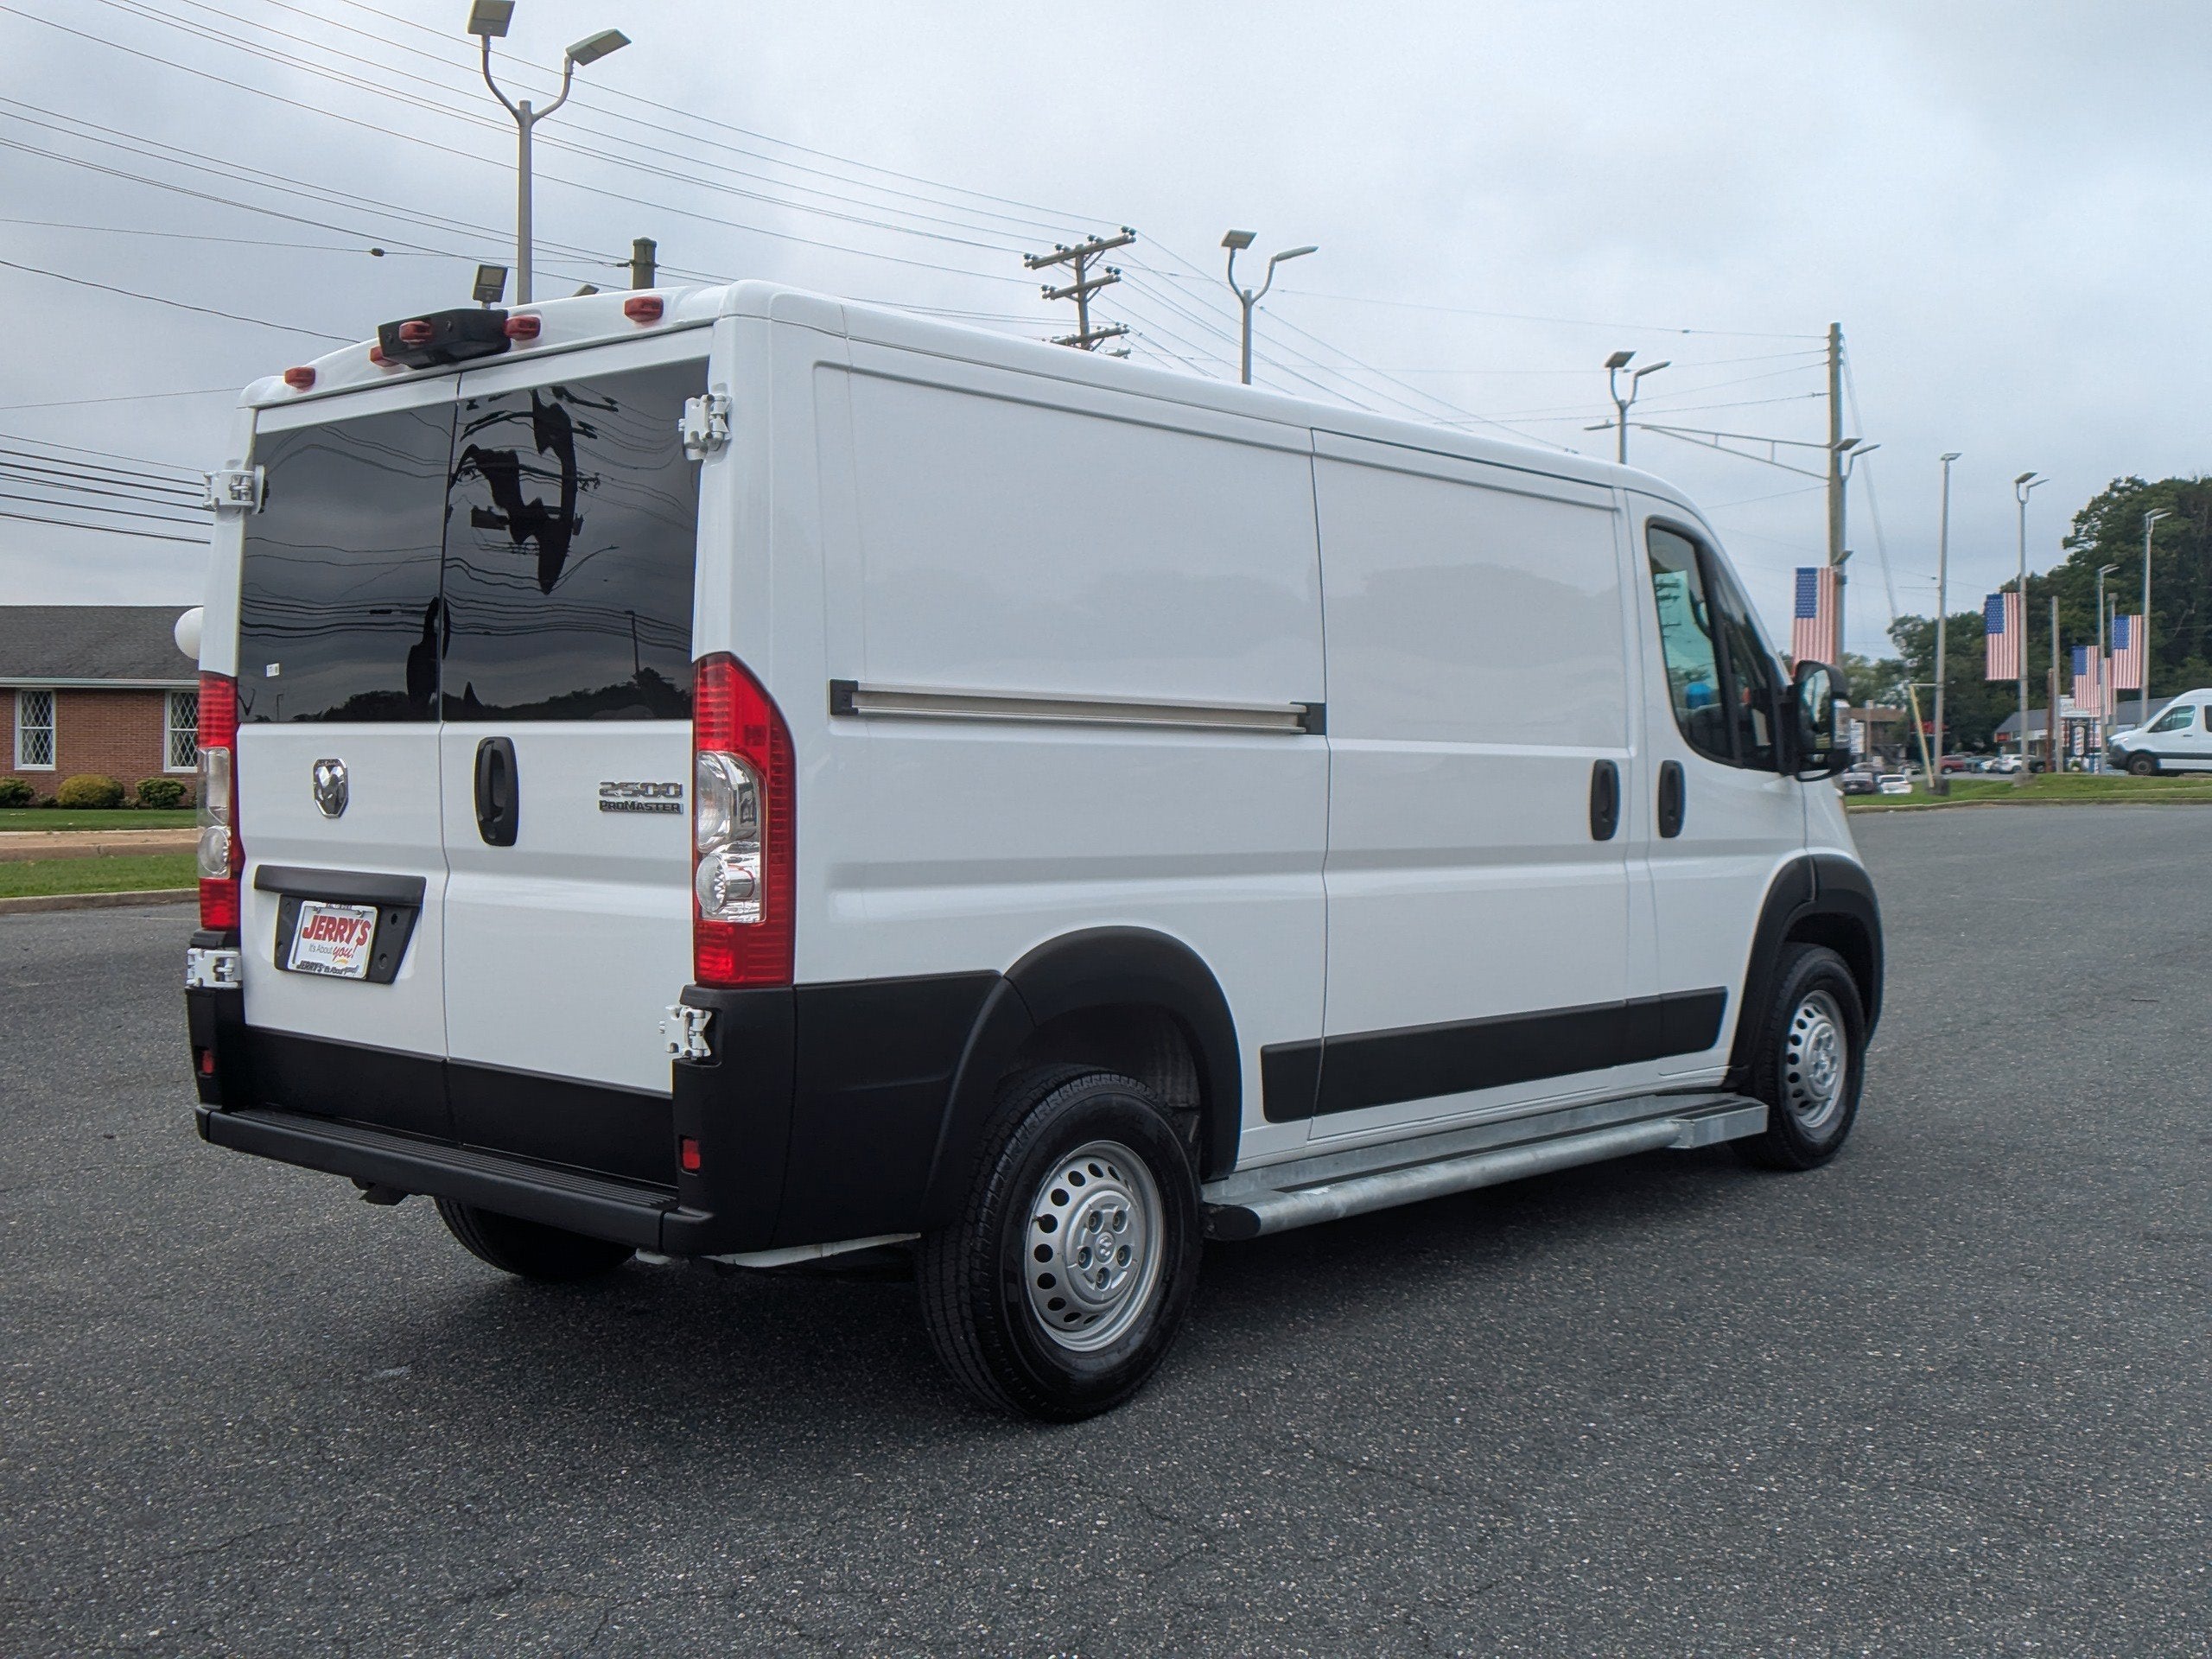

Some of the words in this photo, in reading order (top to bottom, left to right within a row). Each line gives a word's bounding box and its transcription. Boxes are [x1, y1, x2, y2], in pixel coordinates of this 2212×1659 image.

[599, 782, 683, 798] 2500
[599, 800, 683, 814] PROMASTER
[302, 915, 372, 946] JERRY'S
[316, 944, 333, 954] About
[332, 944, 357, 962] you!
